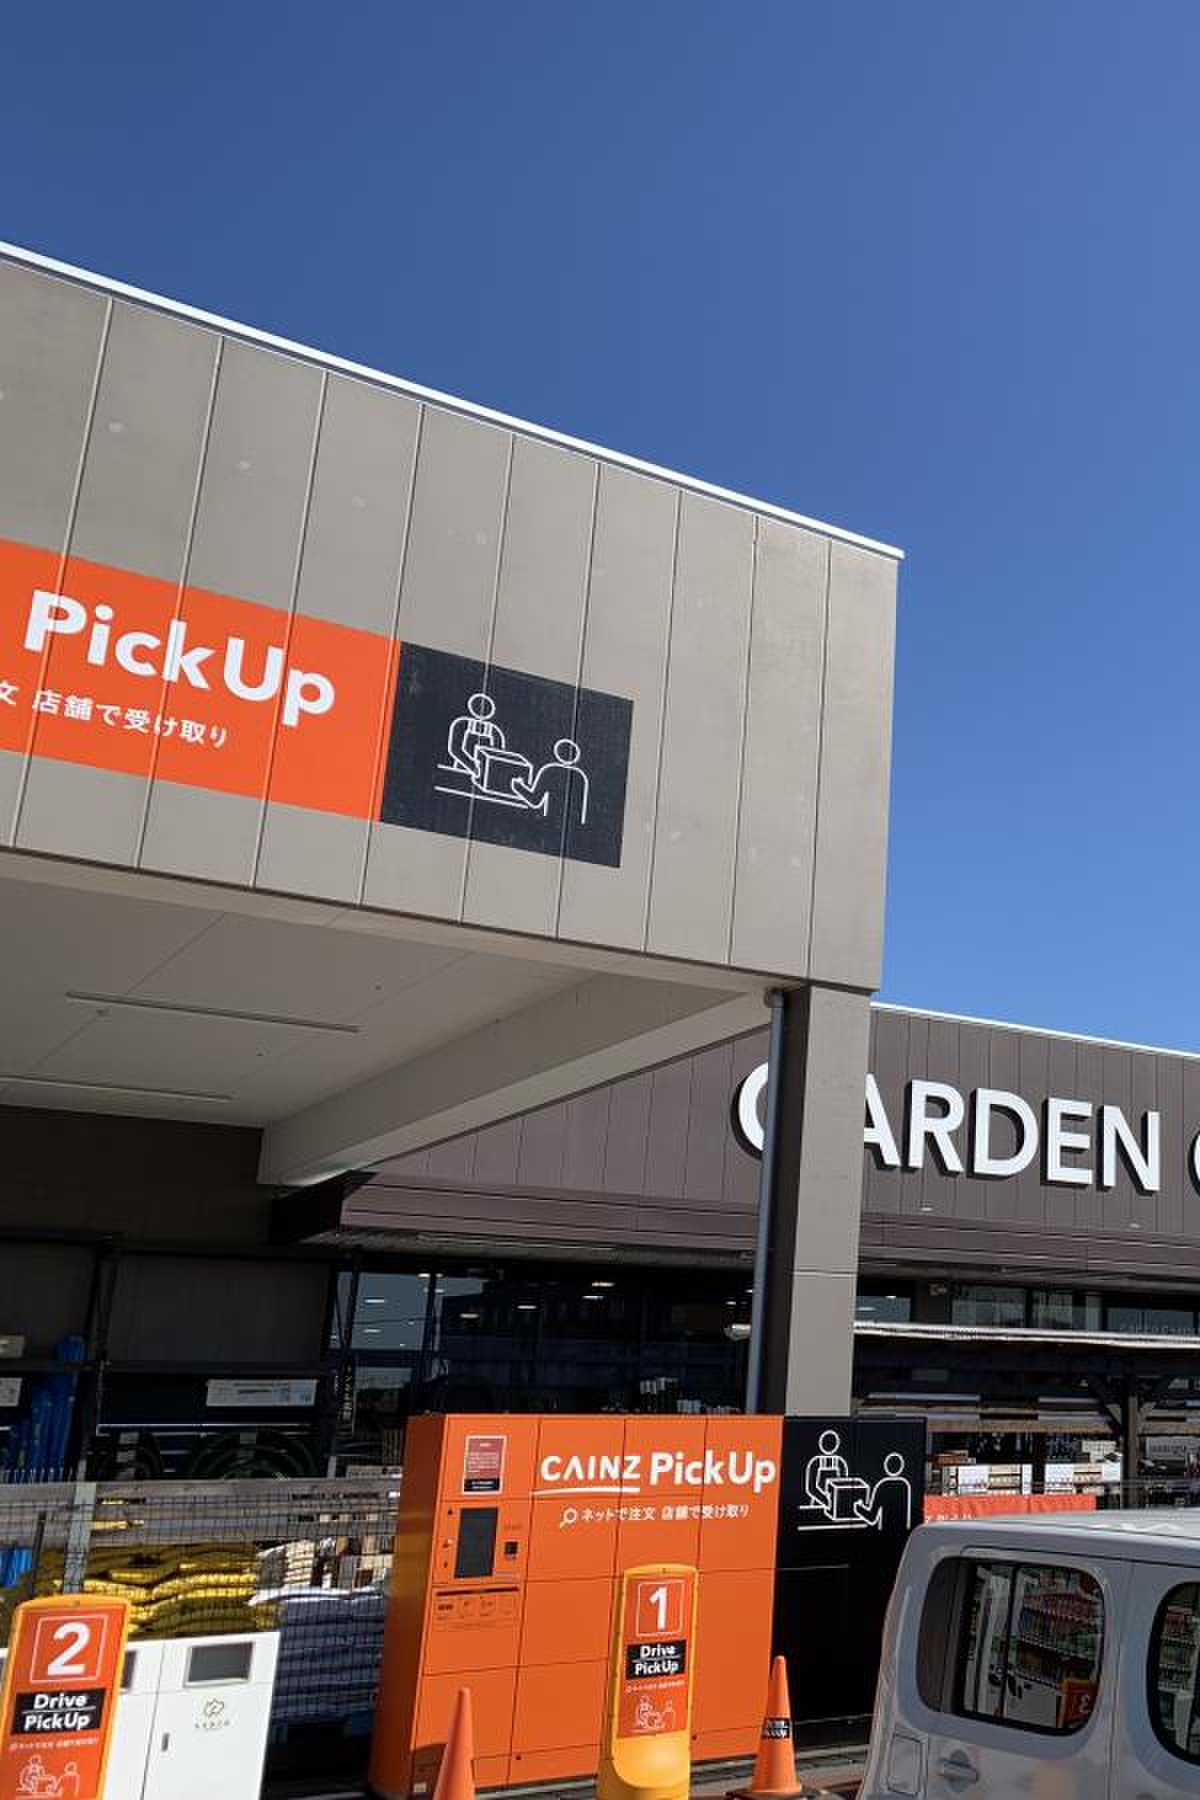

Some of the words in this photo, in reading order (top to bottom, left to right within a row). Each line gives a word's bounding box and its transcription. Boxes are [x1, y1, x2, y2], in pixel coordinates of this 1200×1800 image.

[24, 589, 335, 728] PickUp
[32, 689, 228, 748] 店舗で受け取り
[541, 1455, 641, 1481] CAINZ
[649, 1450, 777, 1494] PickUp
[581, 1505, 656, 1521] ネットで注文
[661, 1503, 751, 1521] 店舗で受け取り
[649, 1587, 667, 1630] 1
[47, 1621, 91, 1676] 2
[640, 1643, 676, 1659] Drive
[24, 1711, 90, 1731] PickUp
[33, 1692, 88, 1710] Drive
